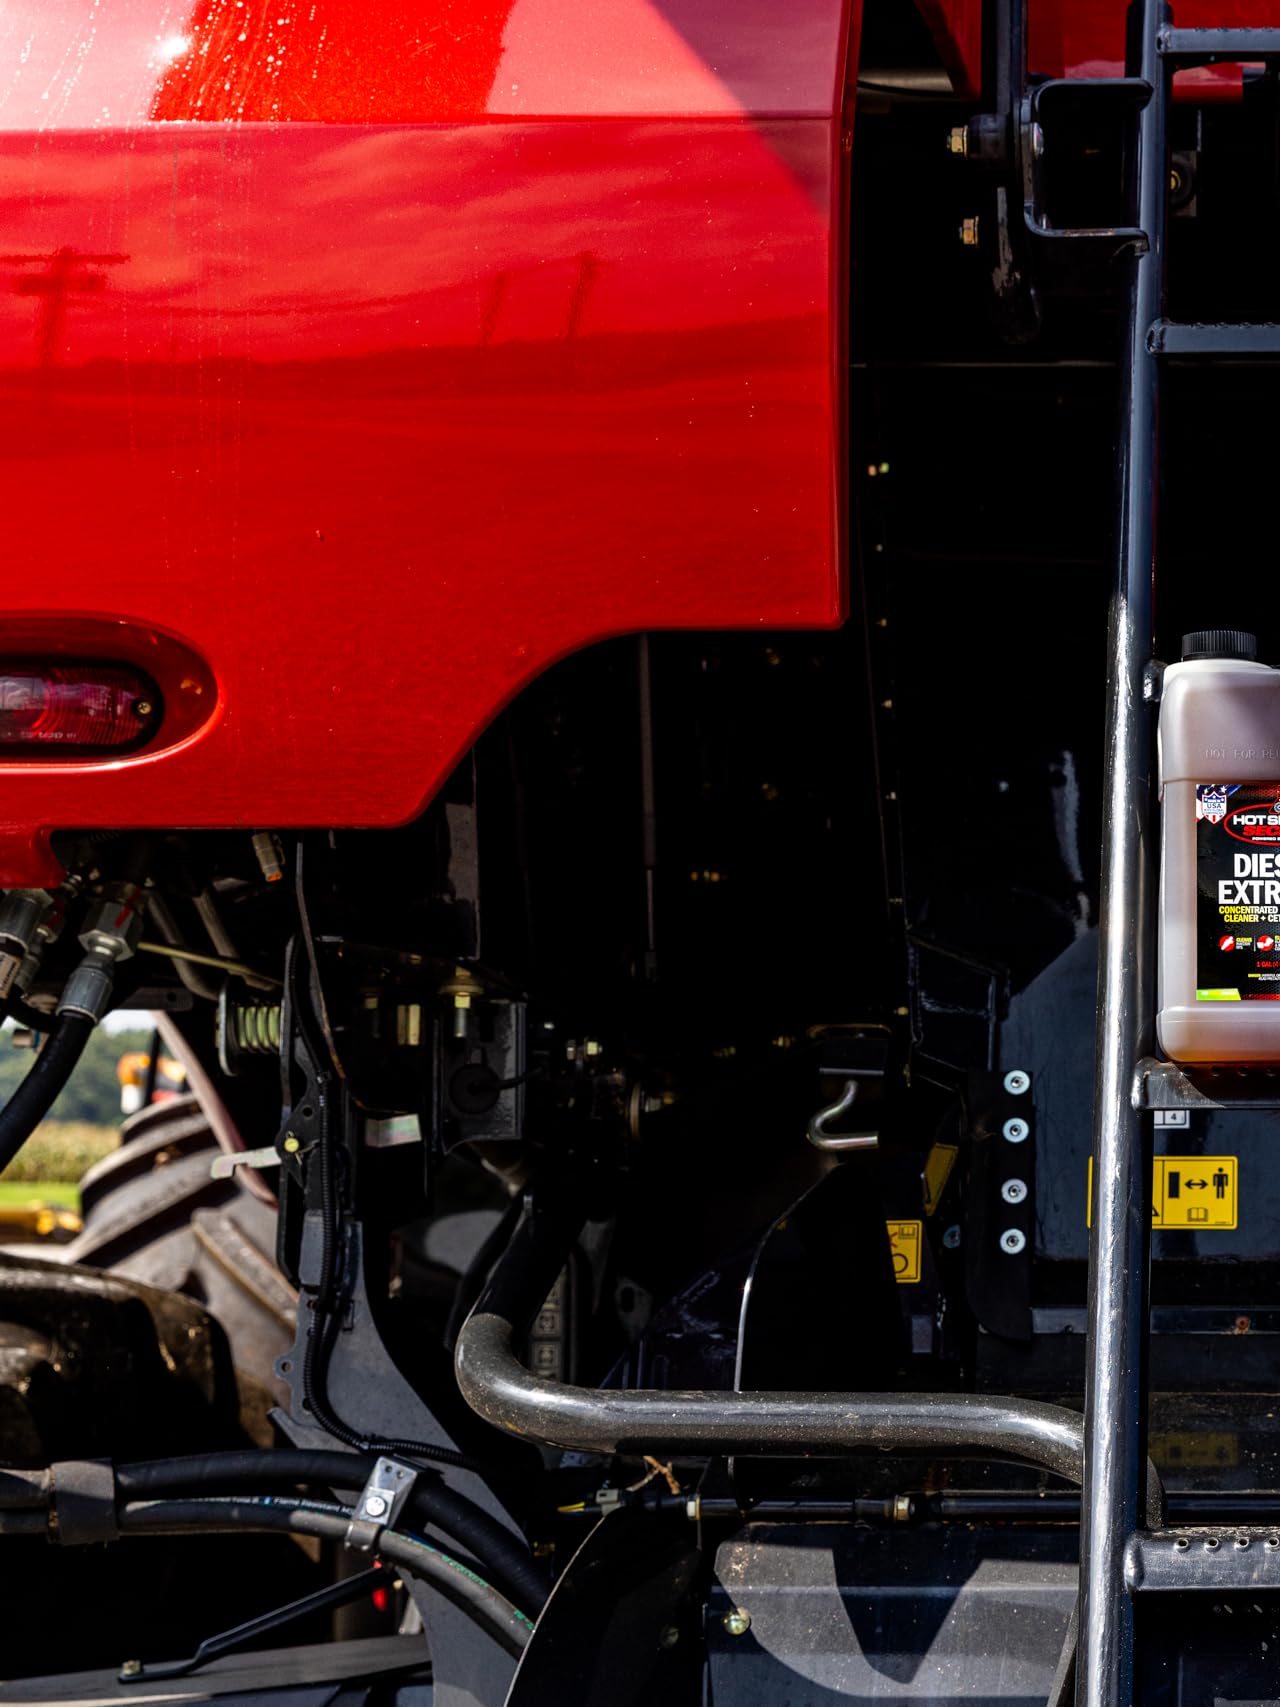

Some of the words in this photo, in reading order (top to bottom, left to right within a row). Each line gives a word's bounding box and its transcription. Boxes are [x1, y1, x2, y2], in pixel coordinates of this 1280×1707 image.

[1205, 748, 1225, 759] NOT
[1233, 748, 1256, 759] FOR
[1233, 815, 1266, 825] HOT
[1219, 906, 1278, 914] CONCENTRATED
[1224, 914, 1259, 922] CLEANER
[1170, 1113, 1177, 1121] 4
